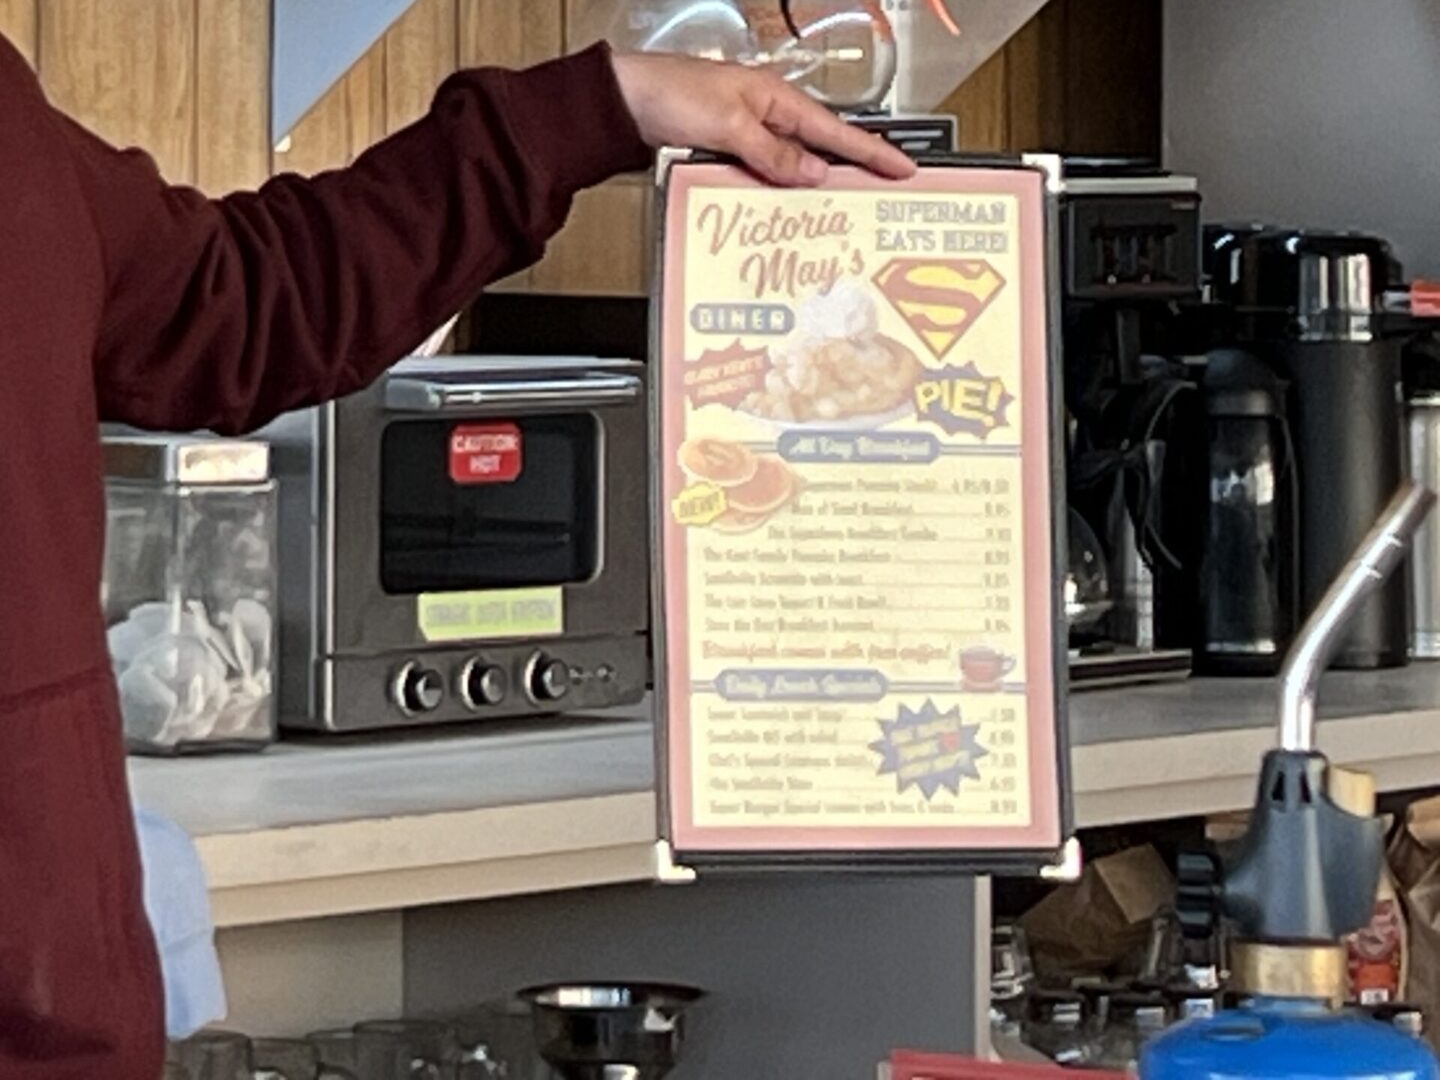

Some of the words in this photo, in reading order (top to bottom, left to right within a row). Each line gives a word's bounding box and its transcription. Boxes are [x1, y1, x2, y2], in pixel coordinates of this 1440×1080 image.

[697, 198, 854, 255] Victoria
[875, 200, 1006, 224] SUPERMAN
[739, 240, 865, 298] May's
[875, 230, 936, 252] EATS
[942, 230, 1009, 254] HERE!
[697, 306, 786, 331] DINER
[915, 377, 1006, 428] PIE!
